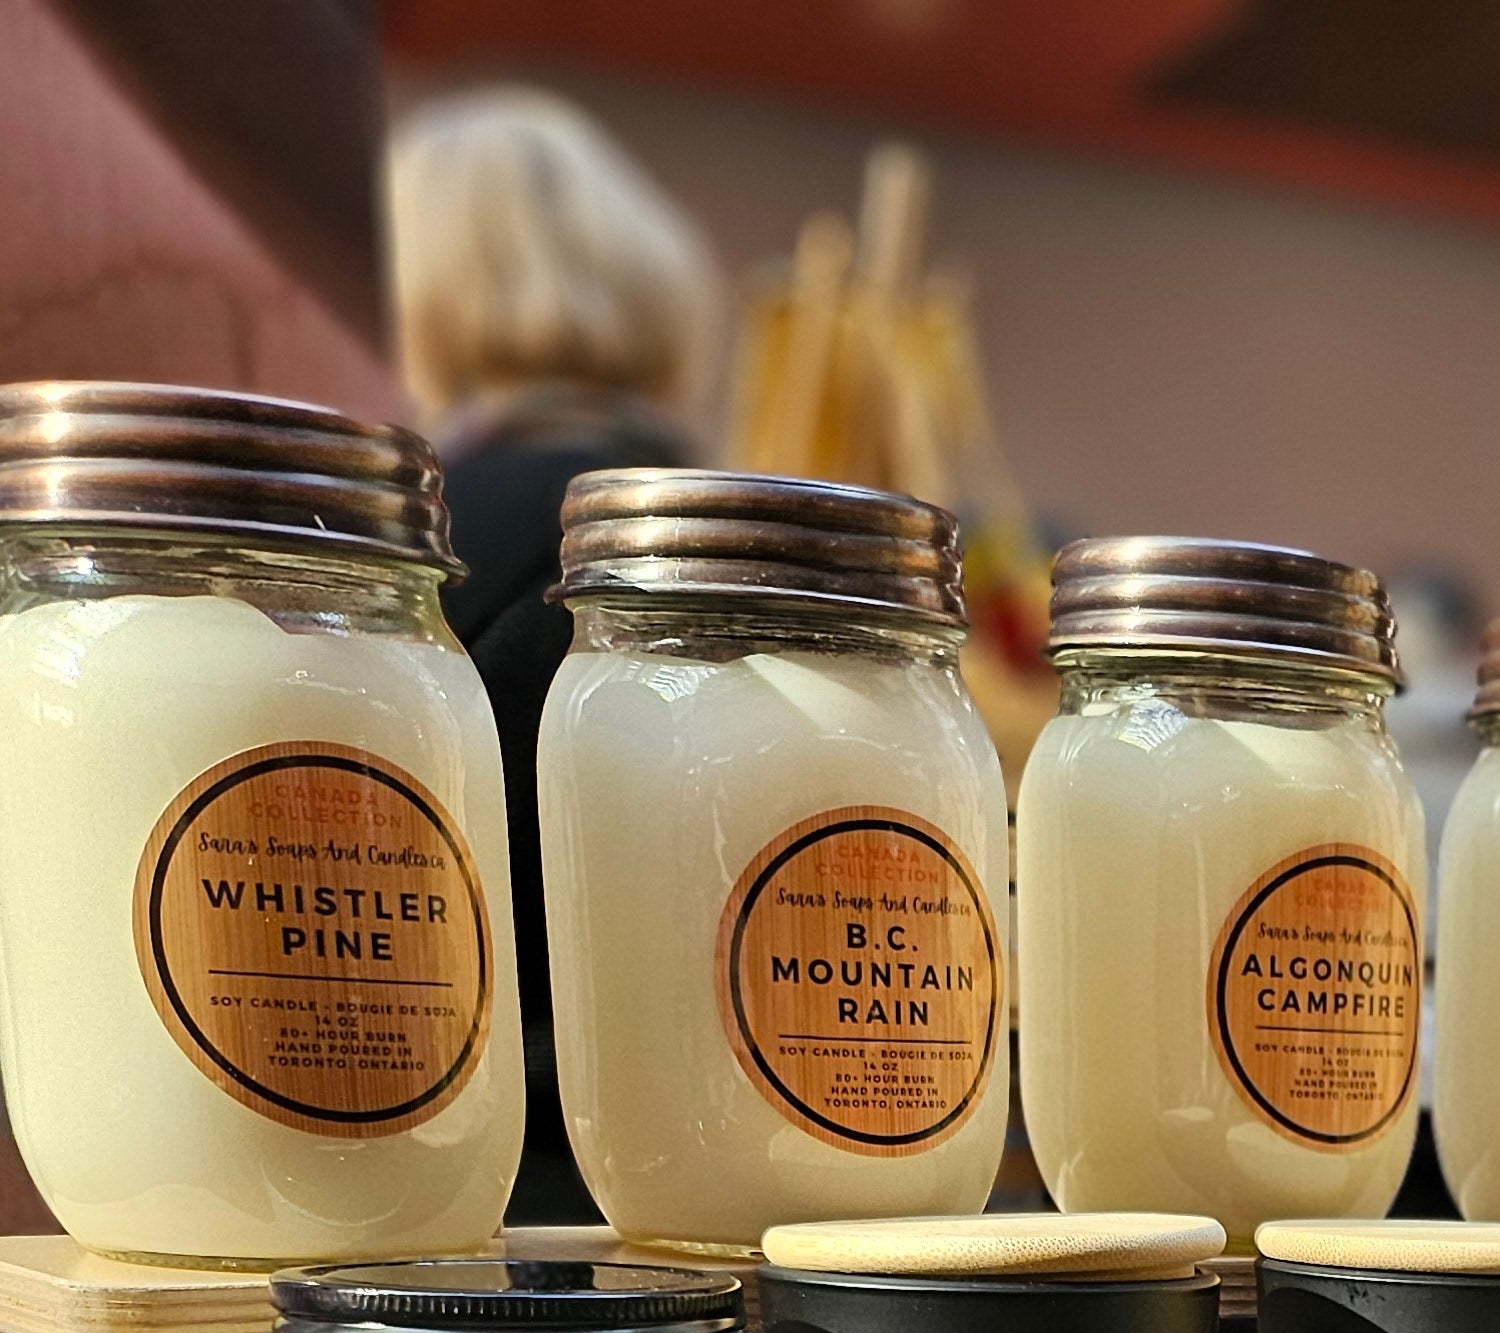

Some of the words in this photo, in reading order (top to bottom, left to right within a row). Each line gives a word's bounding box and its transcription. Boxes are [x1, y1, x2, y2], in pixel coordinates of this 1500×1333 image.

[266, 837, 316, 860] Soaps
[323, 840, 362, 864] And
[202, 879, 448, 924] WHISTLER
[281, 927, 393, 960] PINE
[846, 922, 919, 952] B.C.
[771, 956, 974, 993] MOUNTAIN
[1240, 953, 1413, 988] ALGONQUIN
[210, 996, 242, 1006] SOY
[251, 998, 316, 1011] CANDLE
[838, 997, 929, 1026] RAIN
[1257, 988, 1406, 1018] CAMPFIRE
[276, 1042, 322, 1053] HAND
[316, 1031, 360, 1042] HOUR
[366, 1032, 407, 1043] BURN
[812, 1047, 866, 1059] CANDLE
